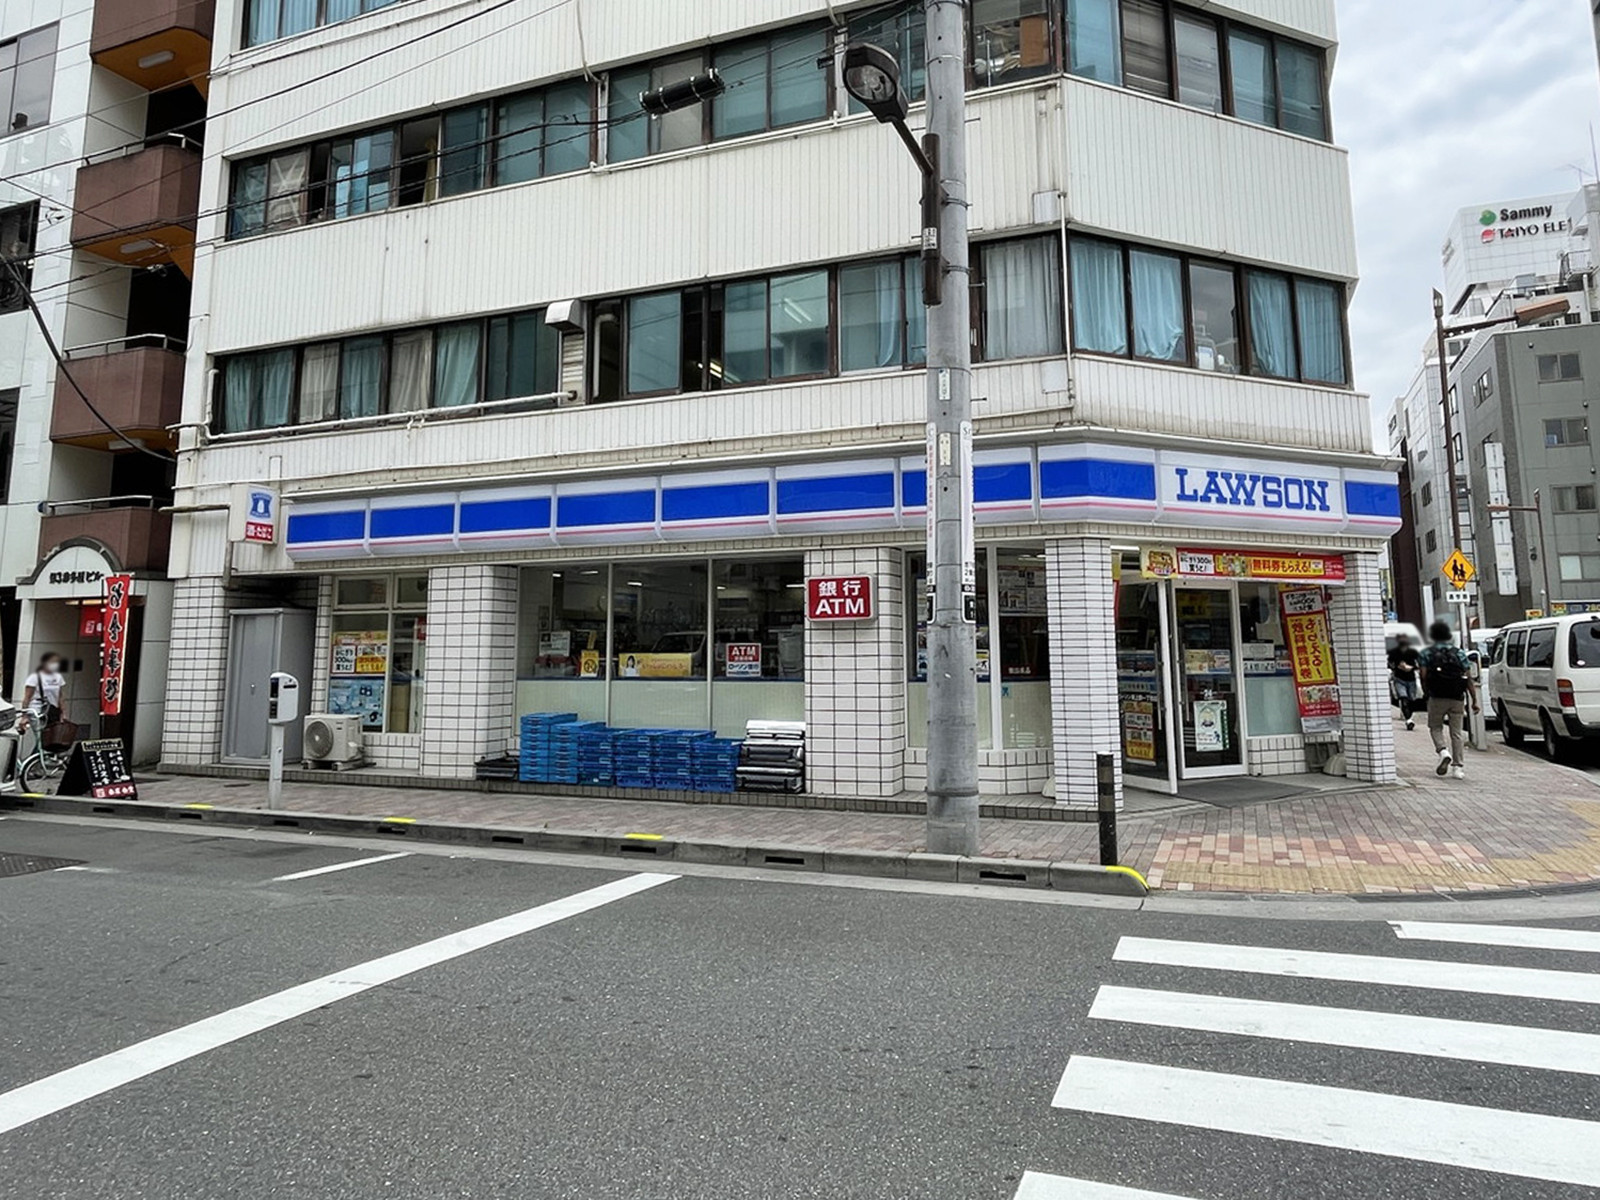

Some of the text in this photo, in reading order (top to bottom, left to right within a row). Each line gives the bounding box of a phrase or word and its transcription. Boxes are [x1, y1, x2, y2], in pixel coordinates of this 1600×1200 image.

[1500, 205, 1552, 221] Sammy
[1498, 224, 1539, 239] TAIYO
[1175, 468, 1330, 511] LAWSON
[818, 580, 861, 596] 銀行
[815, 598, 864, 615] ATM
[732, 646, 756, 655] ATM
